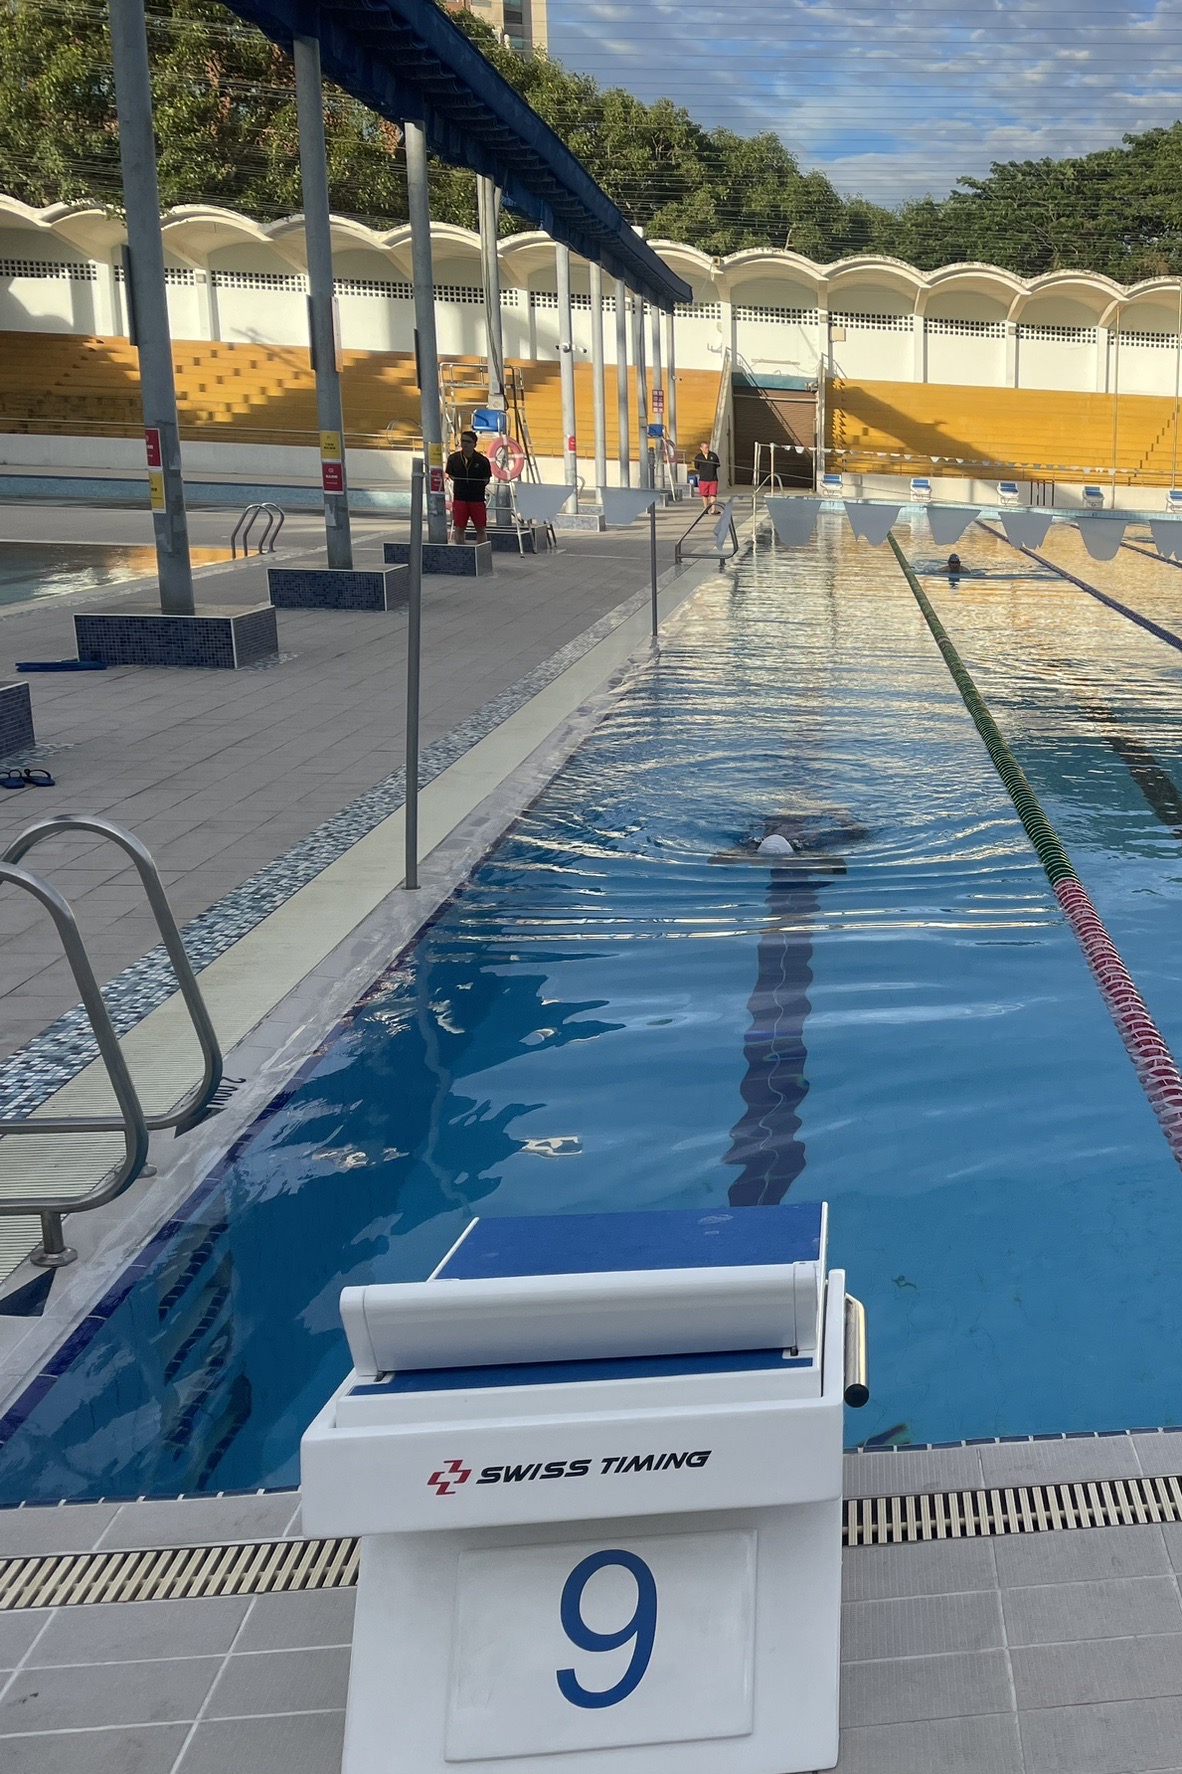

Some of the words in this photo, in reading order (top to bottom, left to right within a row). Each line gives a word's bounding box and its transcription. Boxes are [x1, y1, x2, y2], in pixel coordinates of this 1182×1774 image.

[475, 1459, 592, 1484] SWISS
[600, 1450, 712, 1475] TIMING
[556, 1548, 657, 1709] 9
